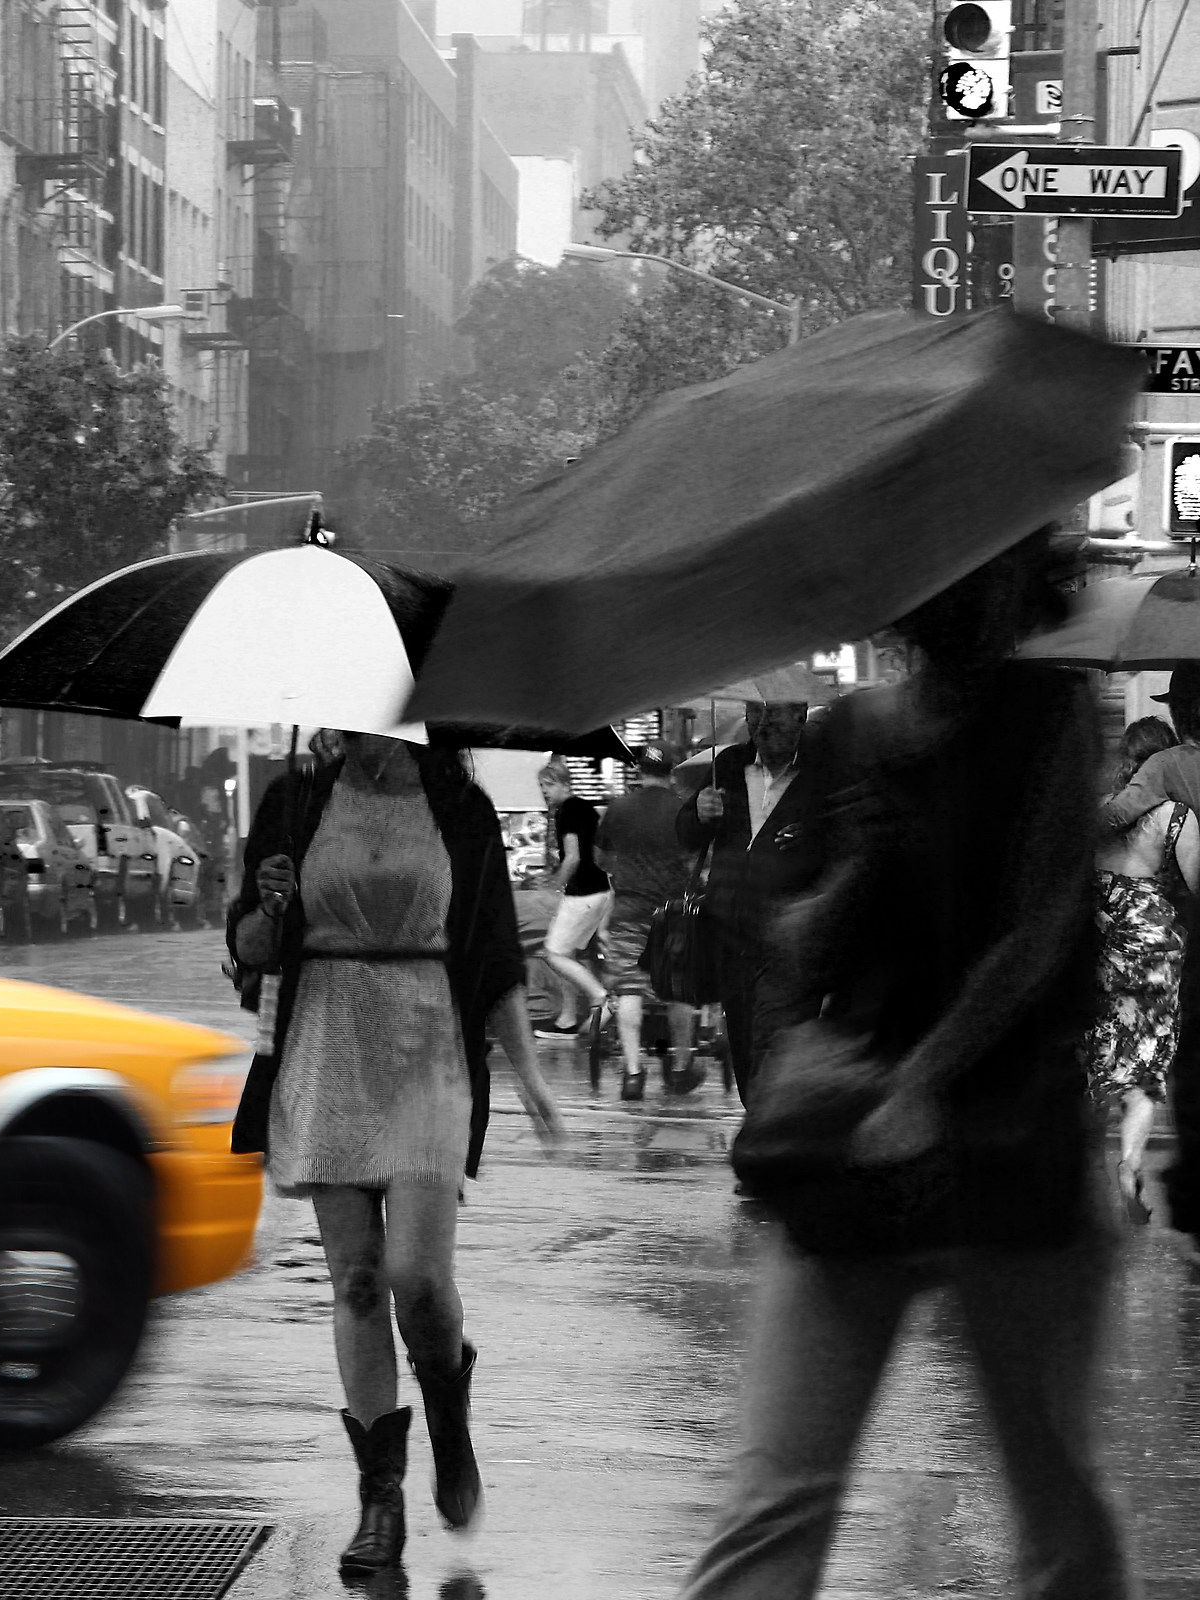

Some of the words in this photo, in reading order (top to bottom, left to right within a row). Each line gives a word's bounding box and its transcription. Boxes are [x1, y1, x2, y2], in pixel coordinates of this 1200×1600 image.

[1001, 167, 1059, 193] ONE
[1088, 168, 1153, 195] WAY
[921, 173, 960, 316] LIQU
[1140, 349, 1200, 374] FA
